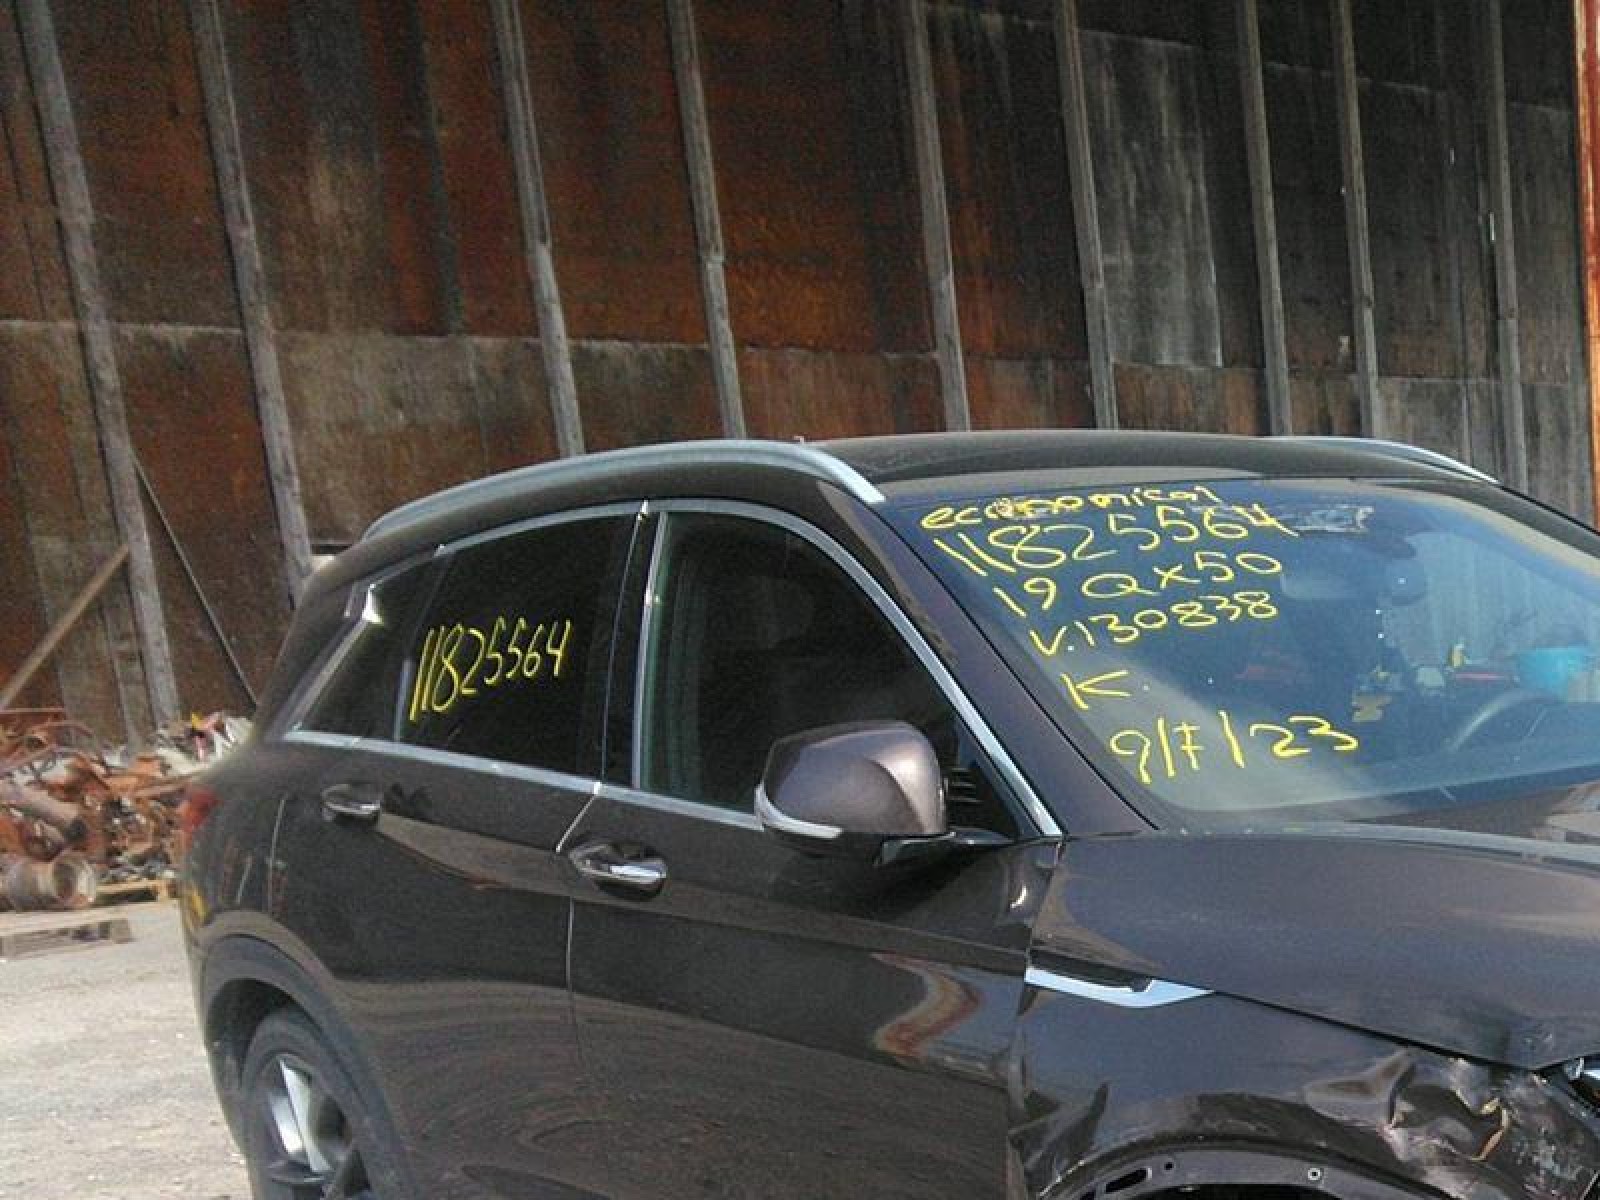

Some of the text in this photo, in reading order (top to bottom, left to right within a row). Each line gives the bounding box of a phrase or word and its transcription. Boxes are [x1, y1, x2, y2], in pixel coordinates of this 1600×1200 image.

[932, 502, 1299, 577] 11825564
[992, 576, 1057, 618] 19
[408, 615, 573, 723] 11825564
[1109, 709, 1360, 784] 9/7/23
